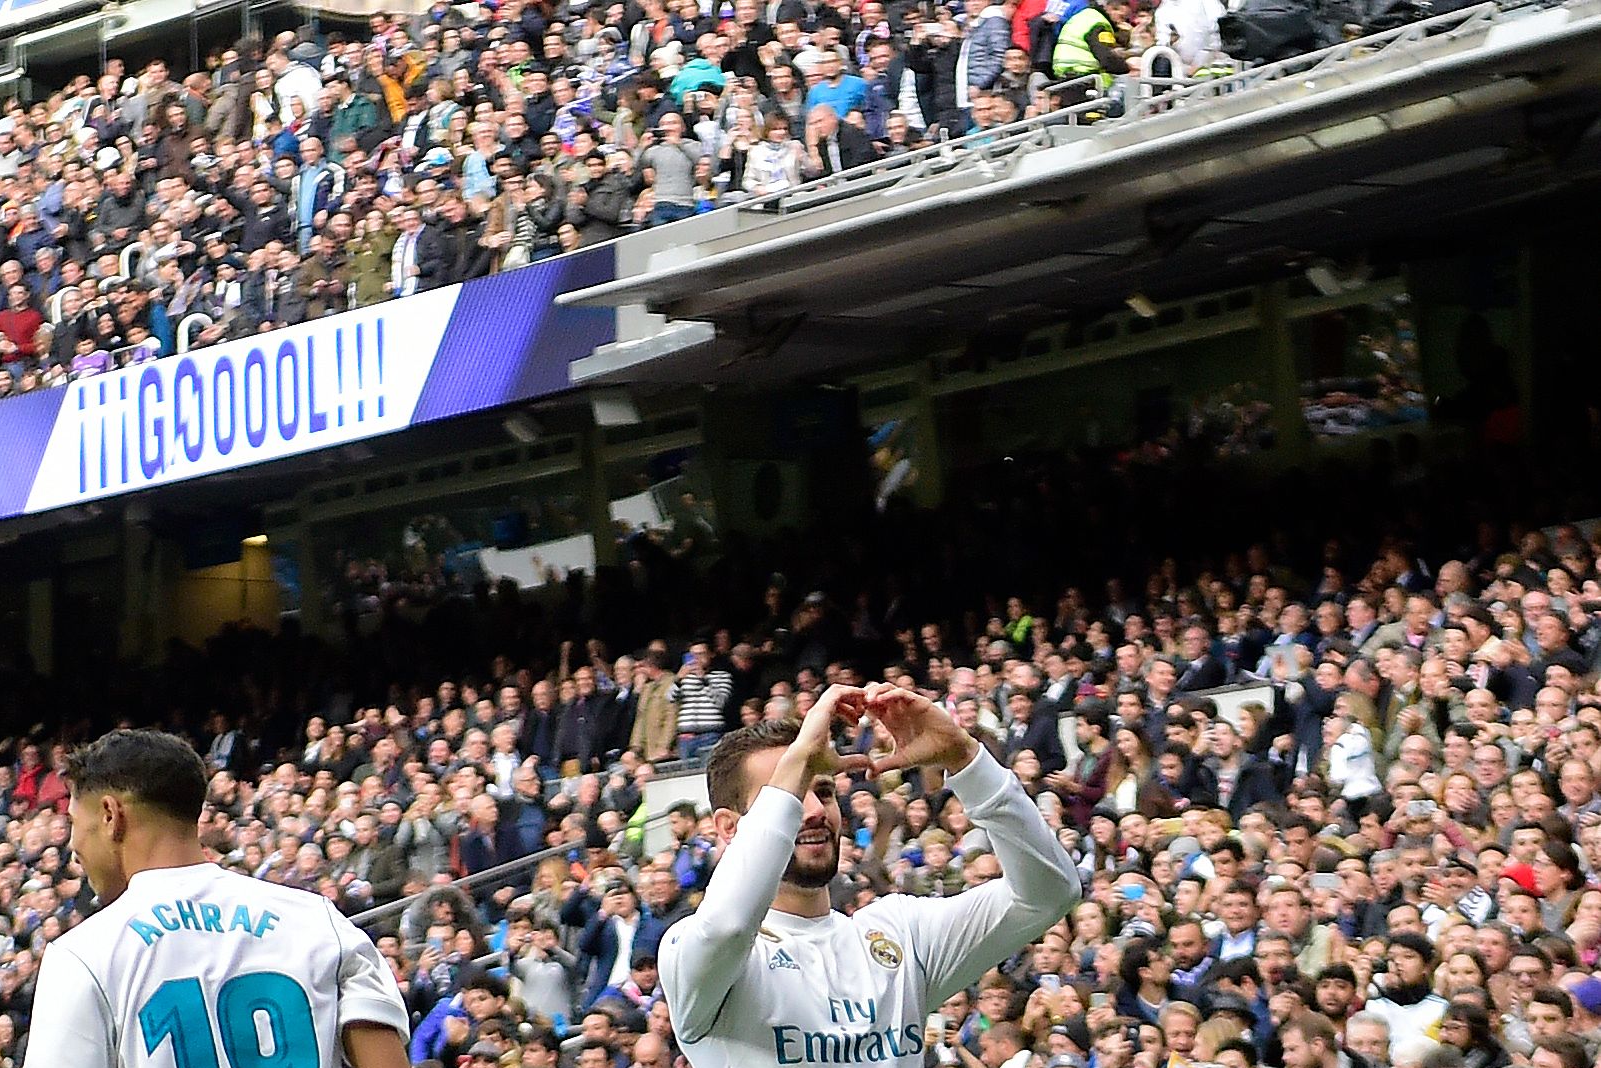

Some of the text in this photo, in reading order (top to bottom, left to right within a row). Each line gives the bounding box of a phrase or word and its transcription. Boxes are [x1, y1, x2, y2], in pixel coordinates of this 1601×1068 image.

[129, 899, 281, 947] ACHRAF
[828, 997, 876, 1024] Fly
[772, 1023, 924, 1065] Emirats
